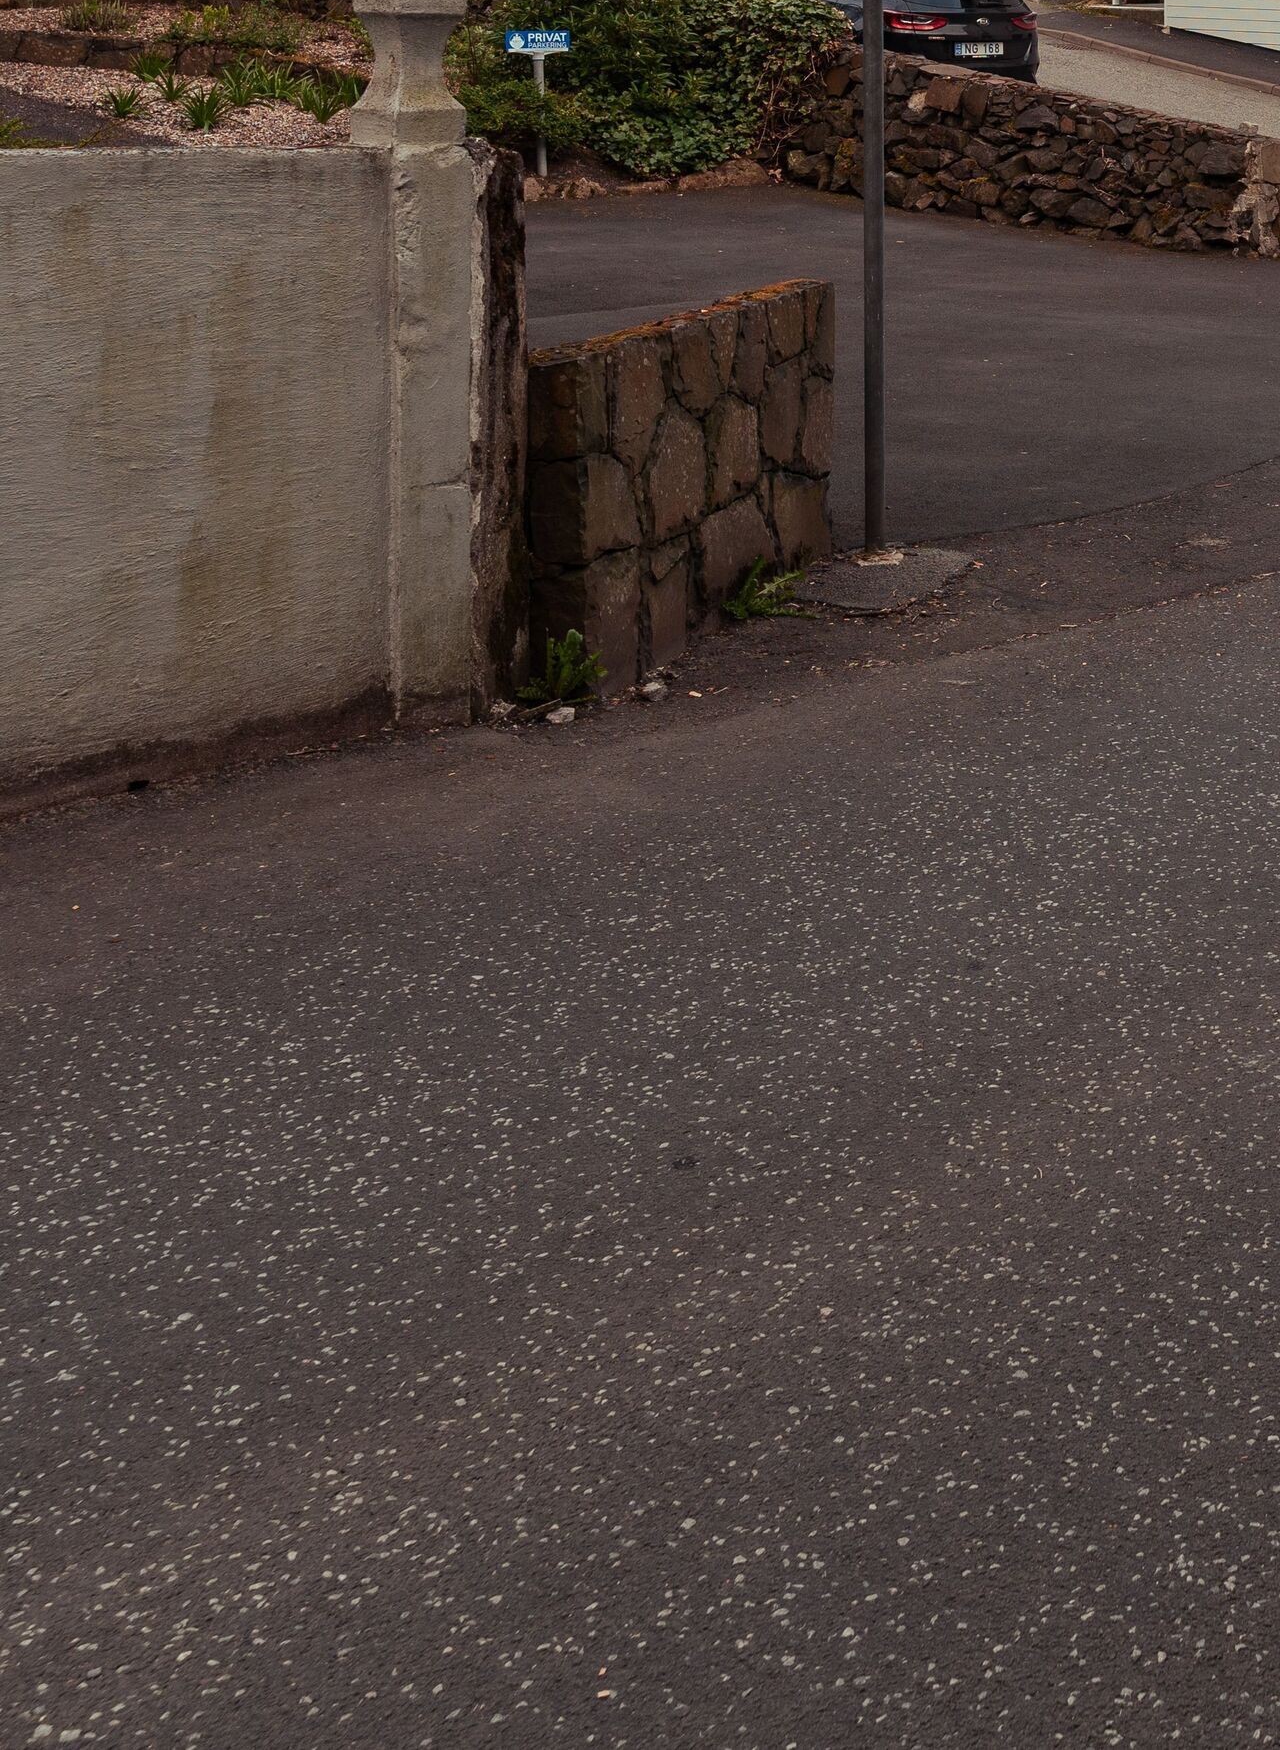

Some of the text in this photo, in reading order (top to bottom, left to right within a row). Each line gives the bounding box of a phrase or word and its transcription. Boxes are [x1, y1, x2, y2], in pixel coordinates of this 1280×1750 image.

[527, 32, 567, 42] PRIVAT
[964, 43, 978, 53] NG
[983, 43, 1000, 53] 168
